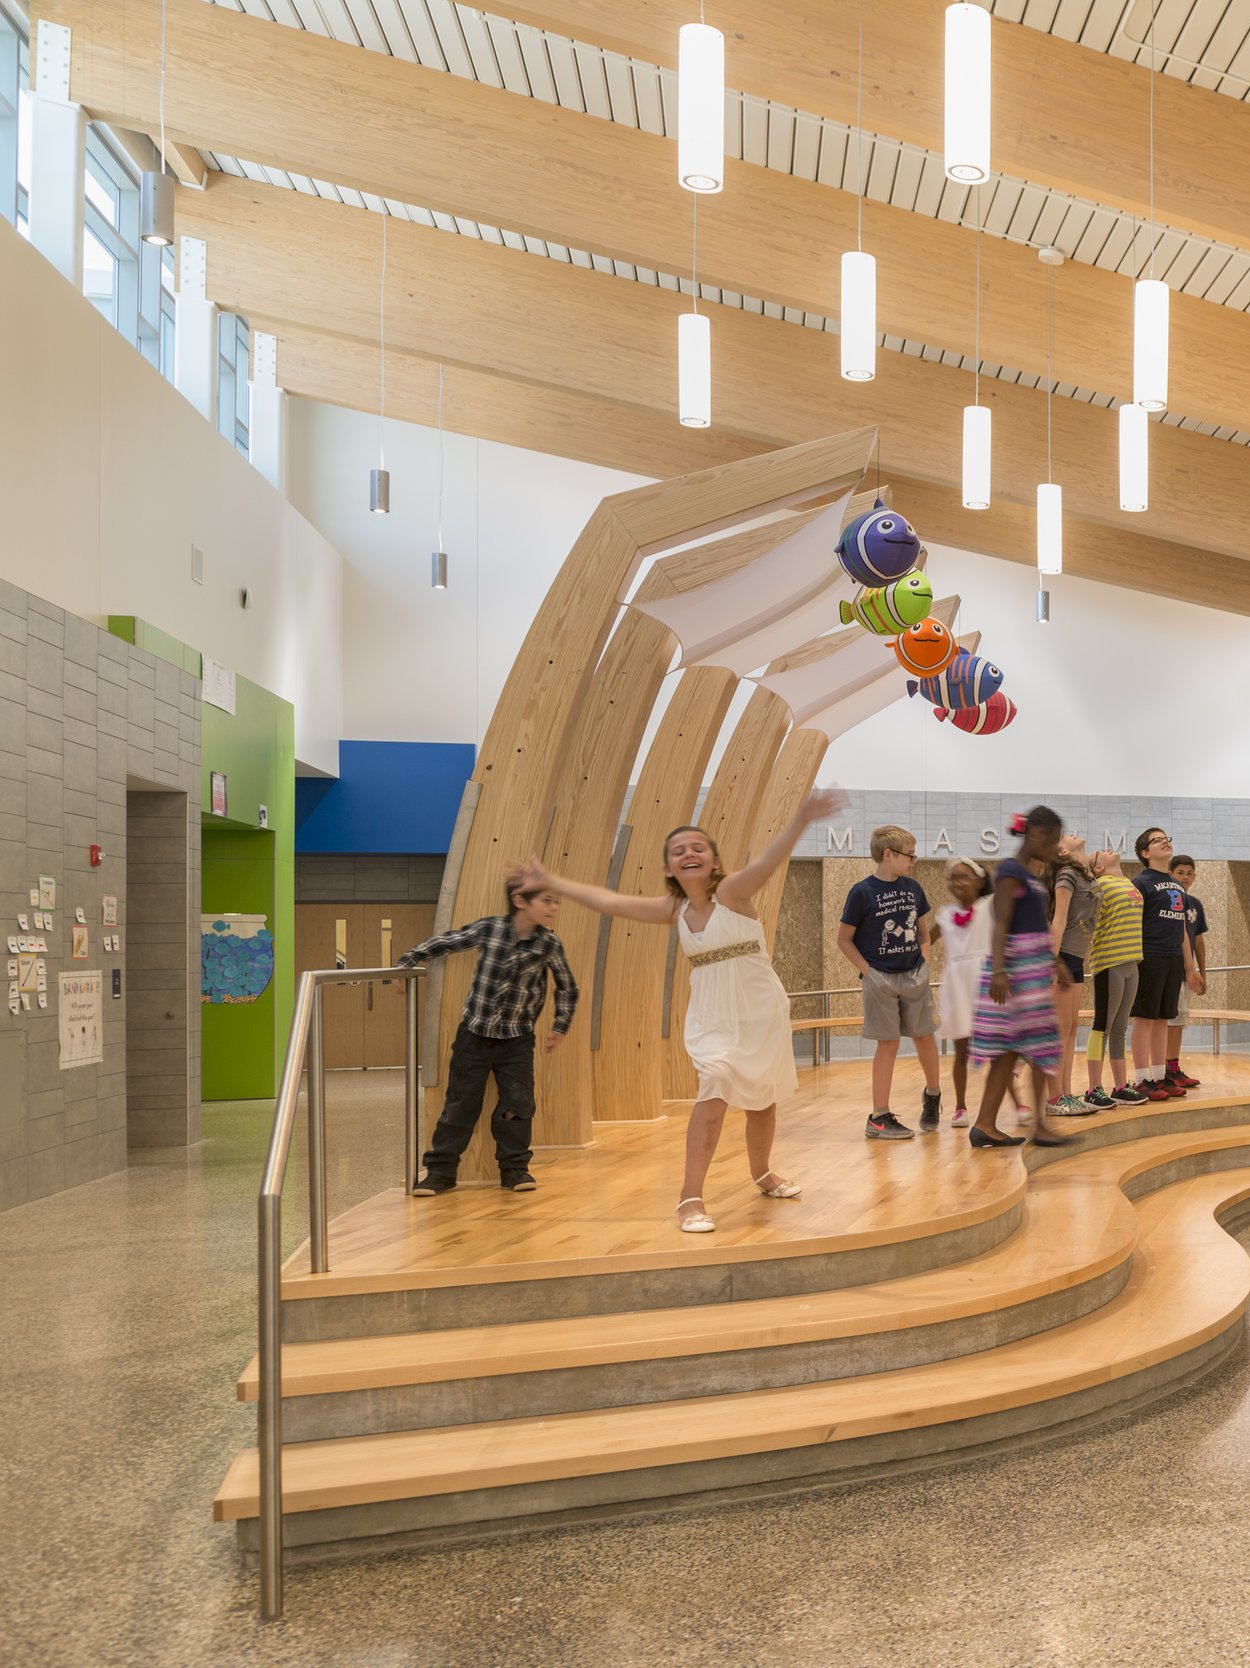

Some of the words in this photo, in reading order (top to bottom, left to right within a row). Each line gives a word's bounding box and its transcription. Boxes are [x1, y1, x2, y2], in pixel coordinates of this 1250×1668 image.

[876, 894, 881, 902] I
[882, 891, 897, 899] didn't
[879, 898, 905, 908] homework
[875, 906, 897, 917] medical
[887, 945, 904, 954] makes
